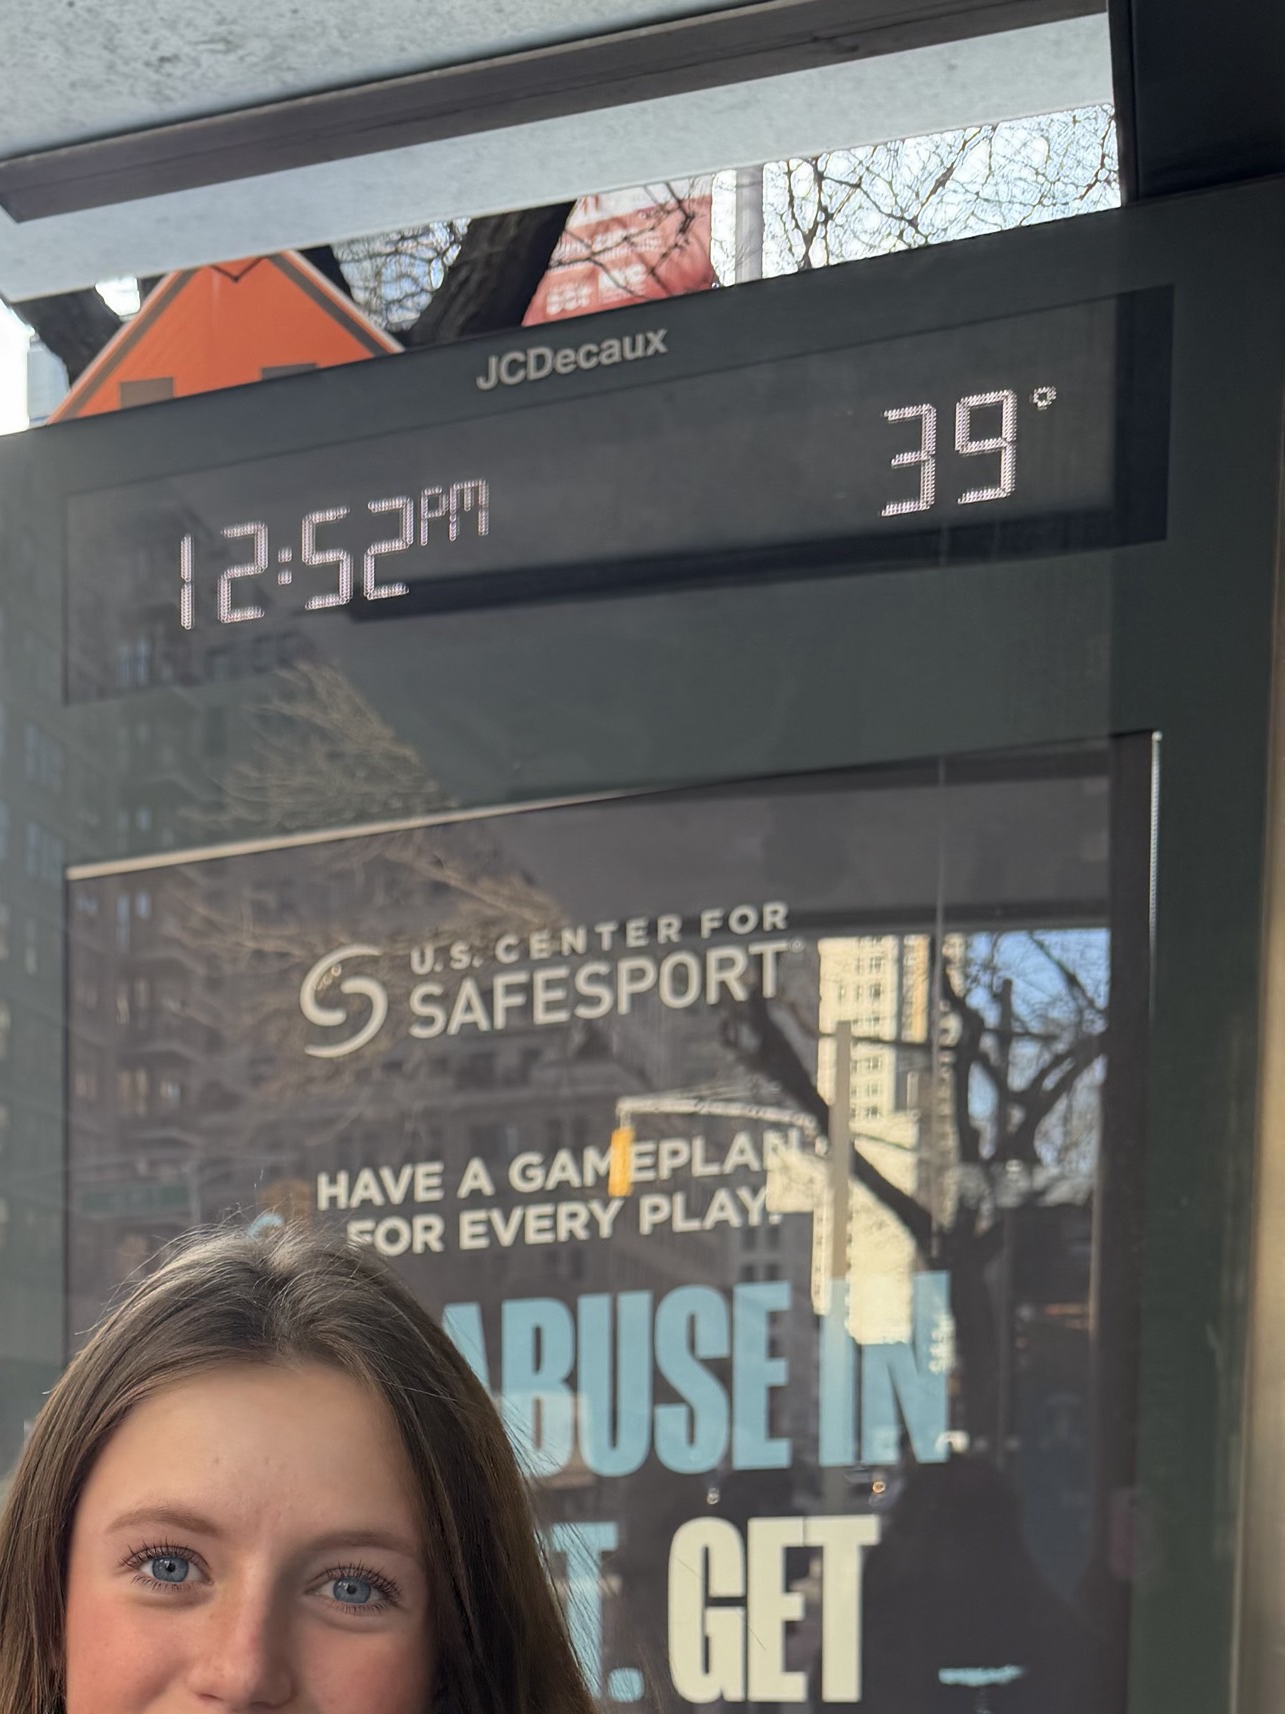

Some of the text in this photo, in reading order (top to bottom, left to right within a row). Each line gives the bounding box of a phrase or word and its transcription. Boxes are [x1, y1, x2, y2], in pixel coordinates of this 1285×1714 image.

[476, 328, 668, 391] JCDecaux
[411, 901, 789, 976] U.S. CENTER FOR
[317, 1161, 444, 1211] HAVE
[456, 1157, 496, 1199] A
[347, 1213, 445, 1257] FOR
[459, 1199, 623, 1251] EVERY
[818, 1269, 951, 1468] IN
[668, 1514, 881, 1703] GET
